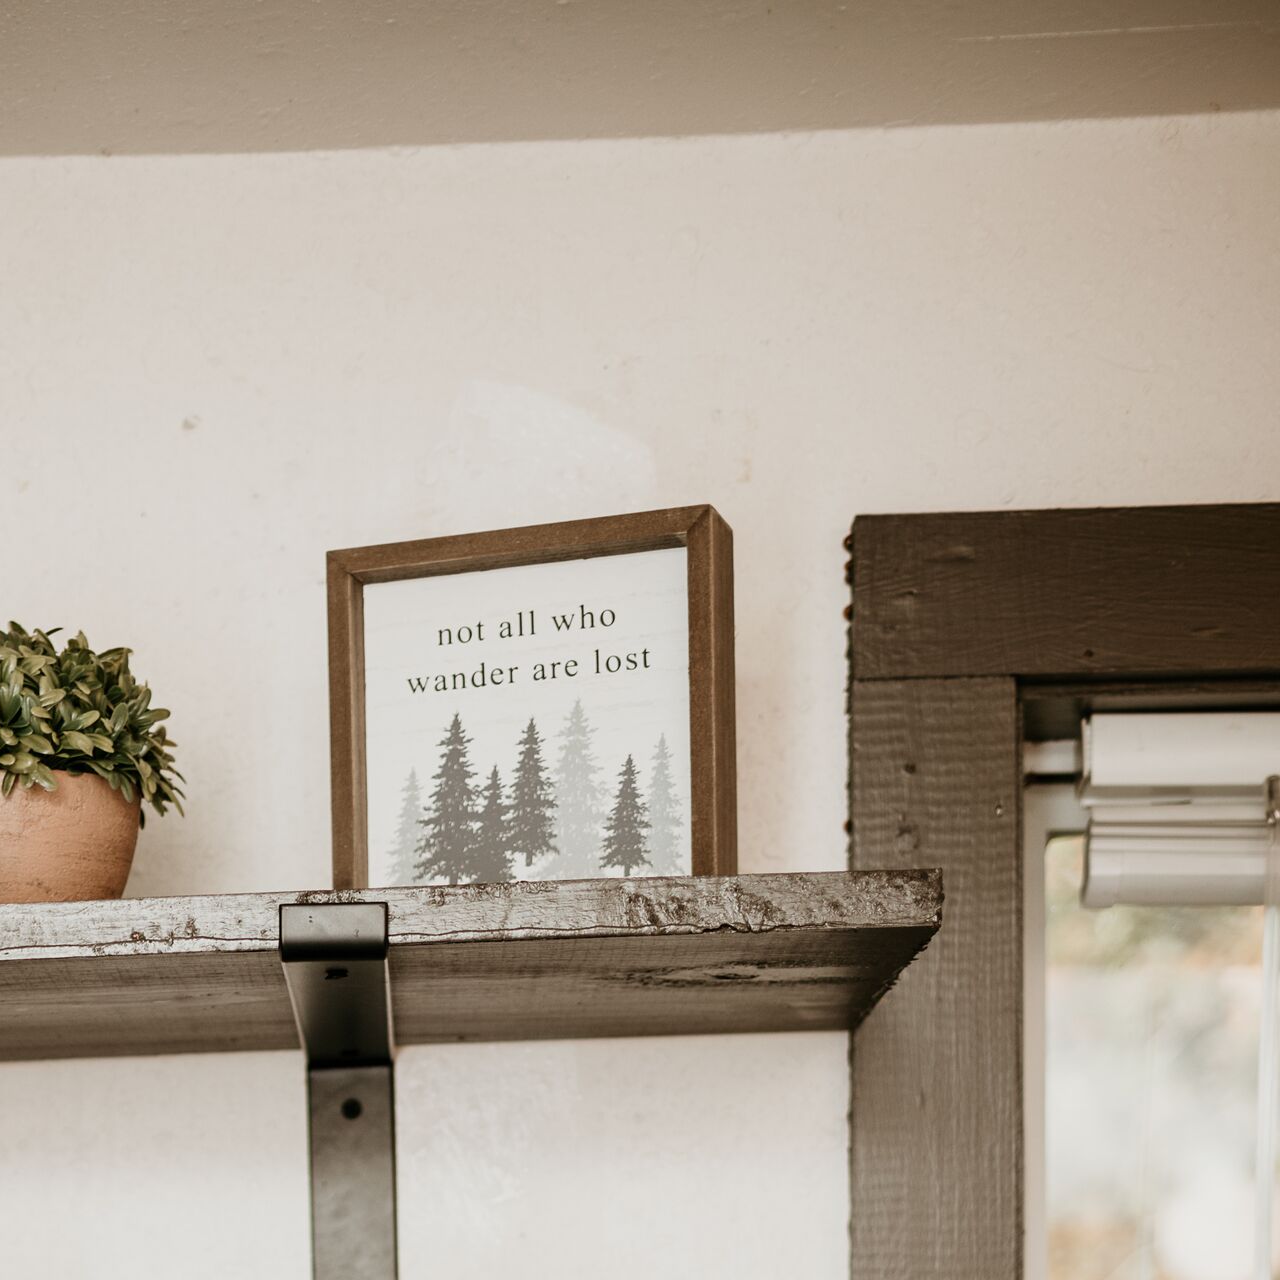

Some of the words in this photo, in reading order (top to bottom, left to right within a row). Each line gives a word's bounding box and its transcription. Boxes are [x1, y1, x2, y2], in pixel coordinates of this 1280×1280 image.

[438, 620, 485, 646] not
[499, 610, 536, 639] all
[552, 604, 616, 632] who
[407, 662, 519, 694] wander
[532, 658, 579, 681] are
[594, 648, 650, 674] lost
